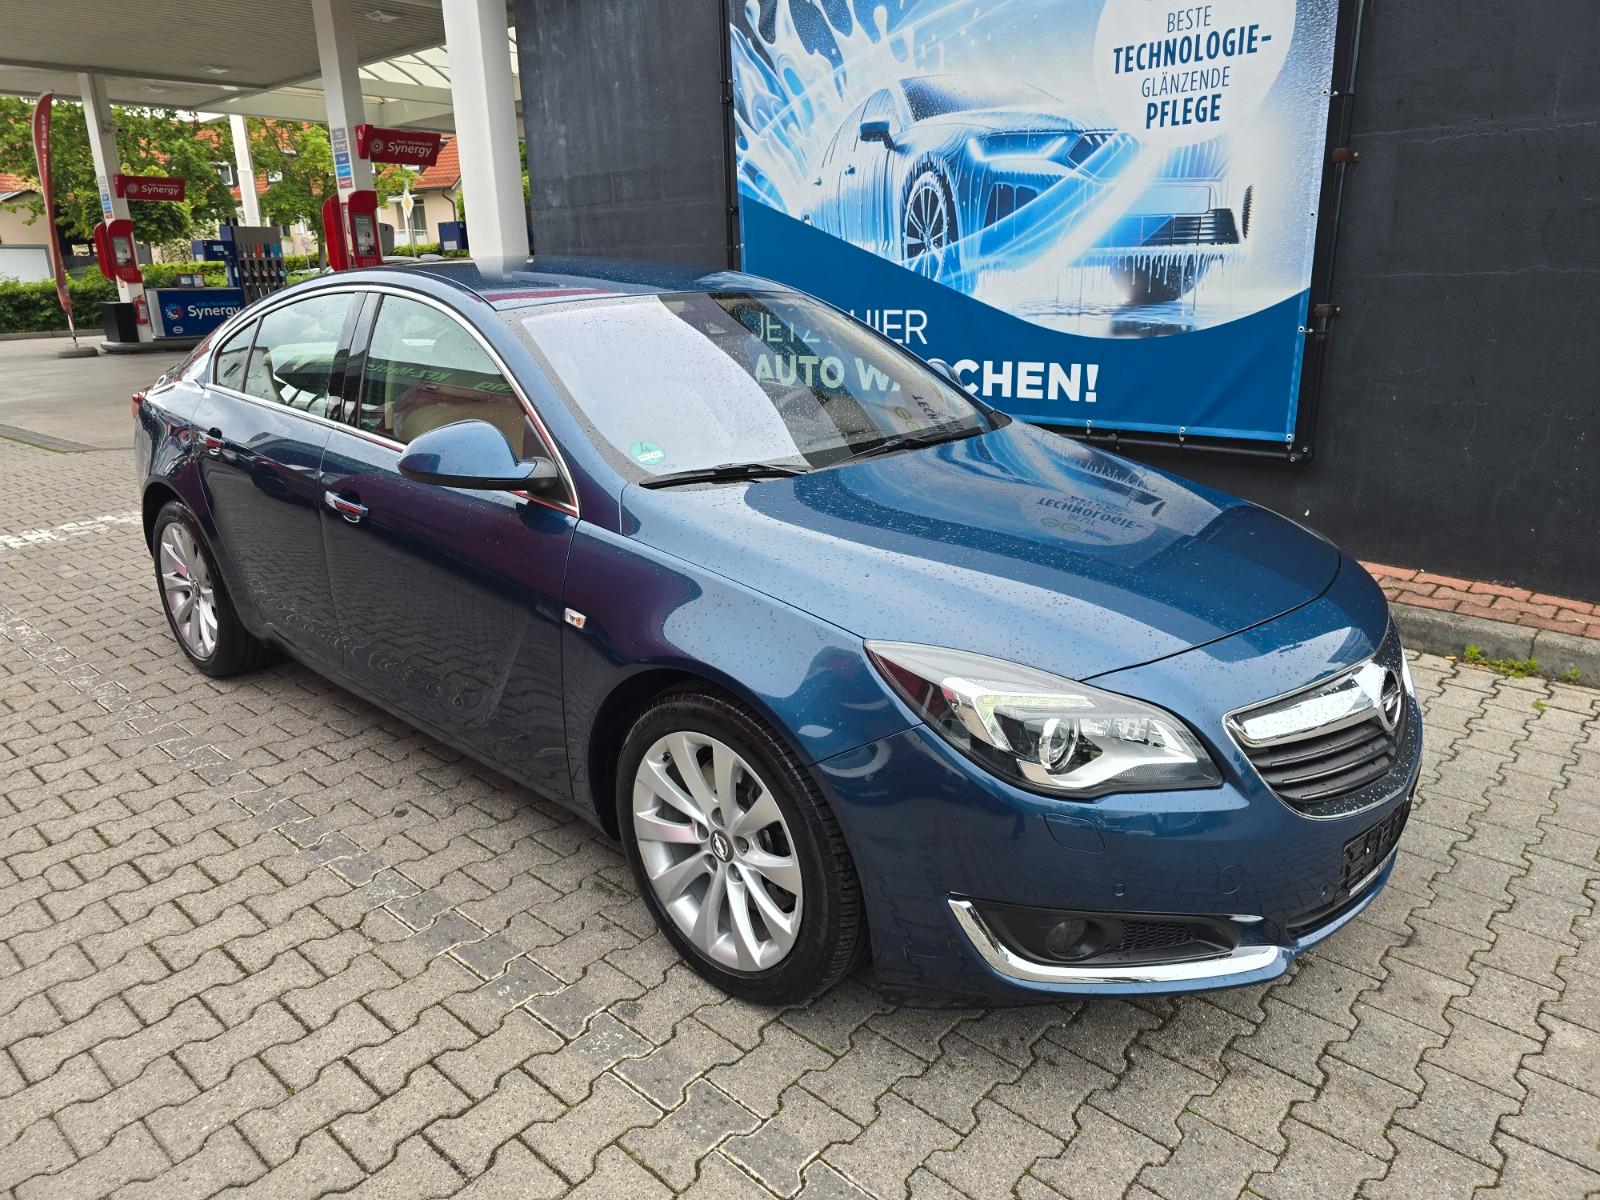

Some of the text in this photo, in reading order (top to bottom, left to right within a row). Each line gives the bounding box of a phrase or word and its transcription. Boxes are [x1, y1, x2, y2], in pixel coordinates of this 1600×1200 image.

[1167, 5, 1212, 33] BESTE
[1113, 24, 1272, 74] TECHNOLOGIE-
[1141, 66, 1231, 98] GLÄNZENDE
[1145, 94, 1222, 129] PFLEGE
[387, 141, 432, 157] Synergy
[141, 184, 180, 196] Synergy
[187, 304, 241, 320] Synergy
[755, 354, 1100, 403] AUTO WCHEN!
